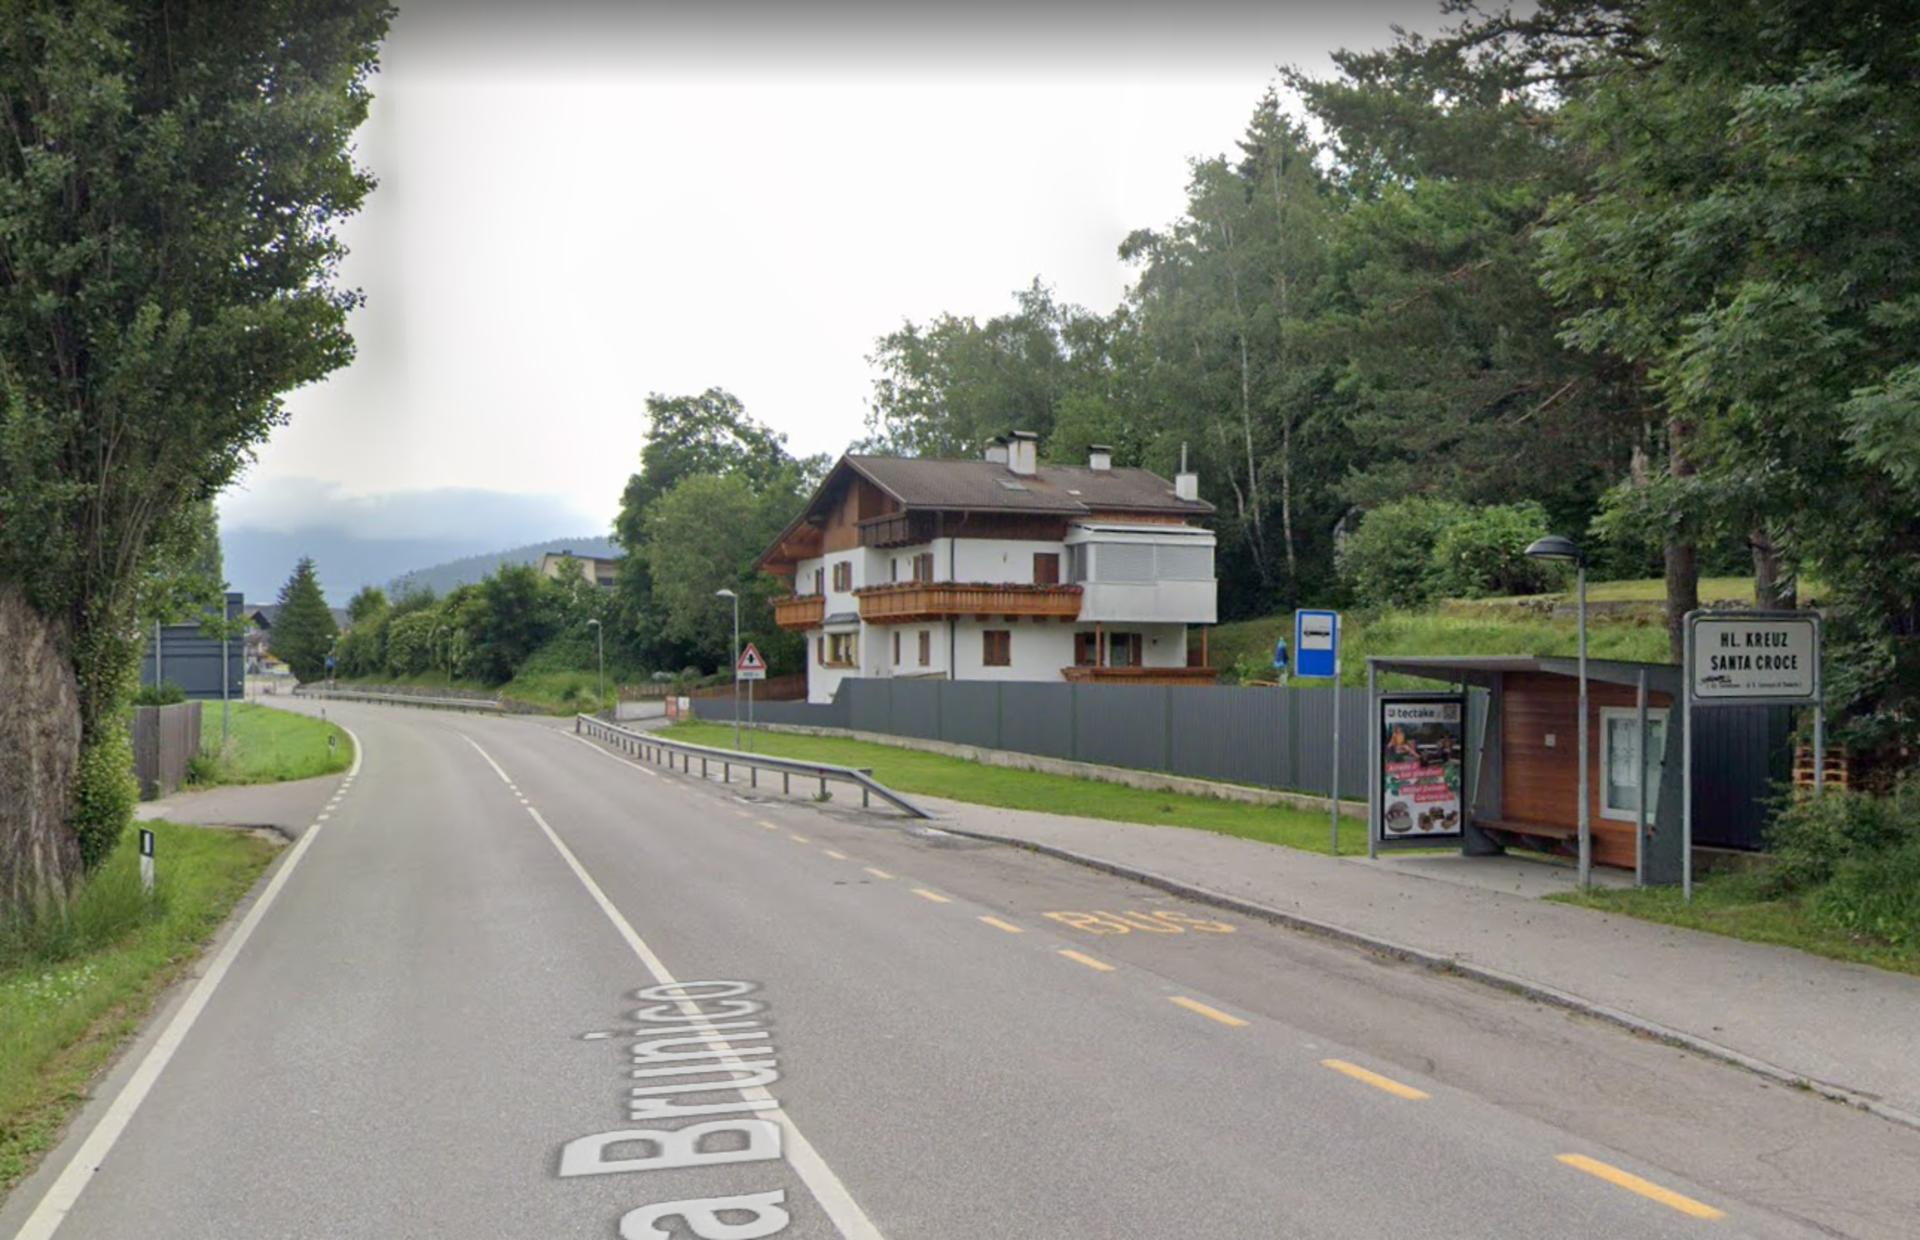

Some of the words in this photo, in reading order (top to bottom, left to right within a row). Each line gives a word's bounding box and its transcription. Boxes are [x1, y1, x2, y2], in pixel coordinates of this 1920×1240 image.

[1720, 632, 1740, 647] HL.
[1746, 632, 1788, 647] KREUZ
[1711, 655, 1752, 670] SANTA
[1756, 655, 1798, 670] CROCE
[1397, 708, 1434, 718] tectake
[1040, 910, 1236, 934] BUS
